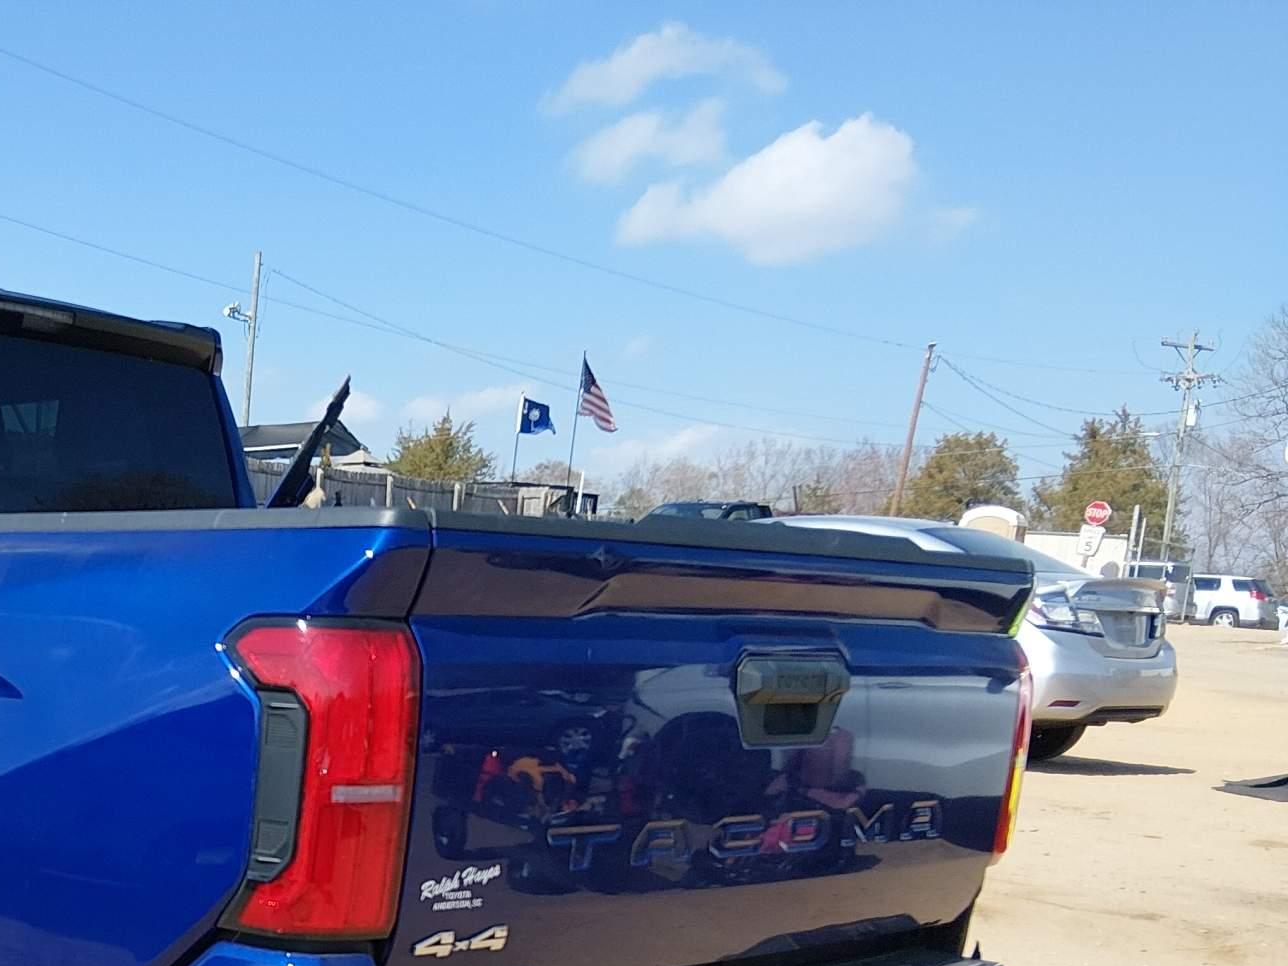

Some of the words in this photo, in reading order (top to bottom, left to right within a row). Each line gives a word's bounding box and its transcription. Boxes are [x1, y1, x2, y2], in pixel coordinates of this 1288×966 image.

[1086, 507, 1108, 518] STOP
[1083, 541, 1093, 552] 5
[546, 799, 943, 872] TACOMA
[420, 870, 461, 902] Ralph
[445, 890, 472, 900] TOYOTA
